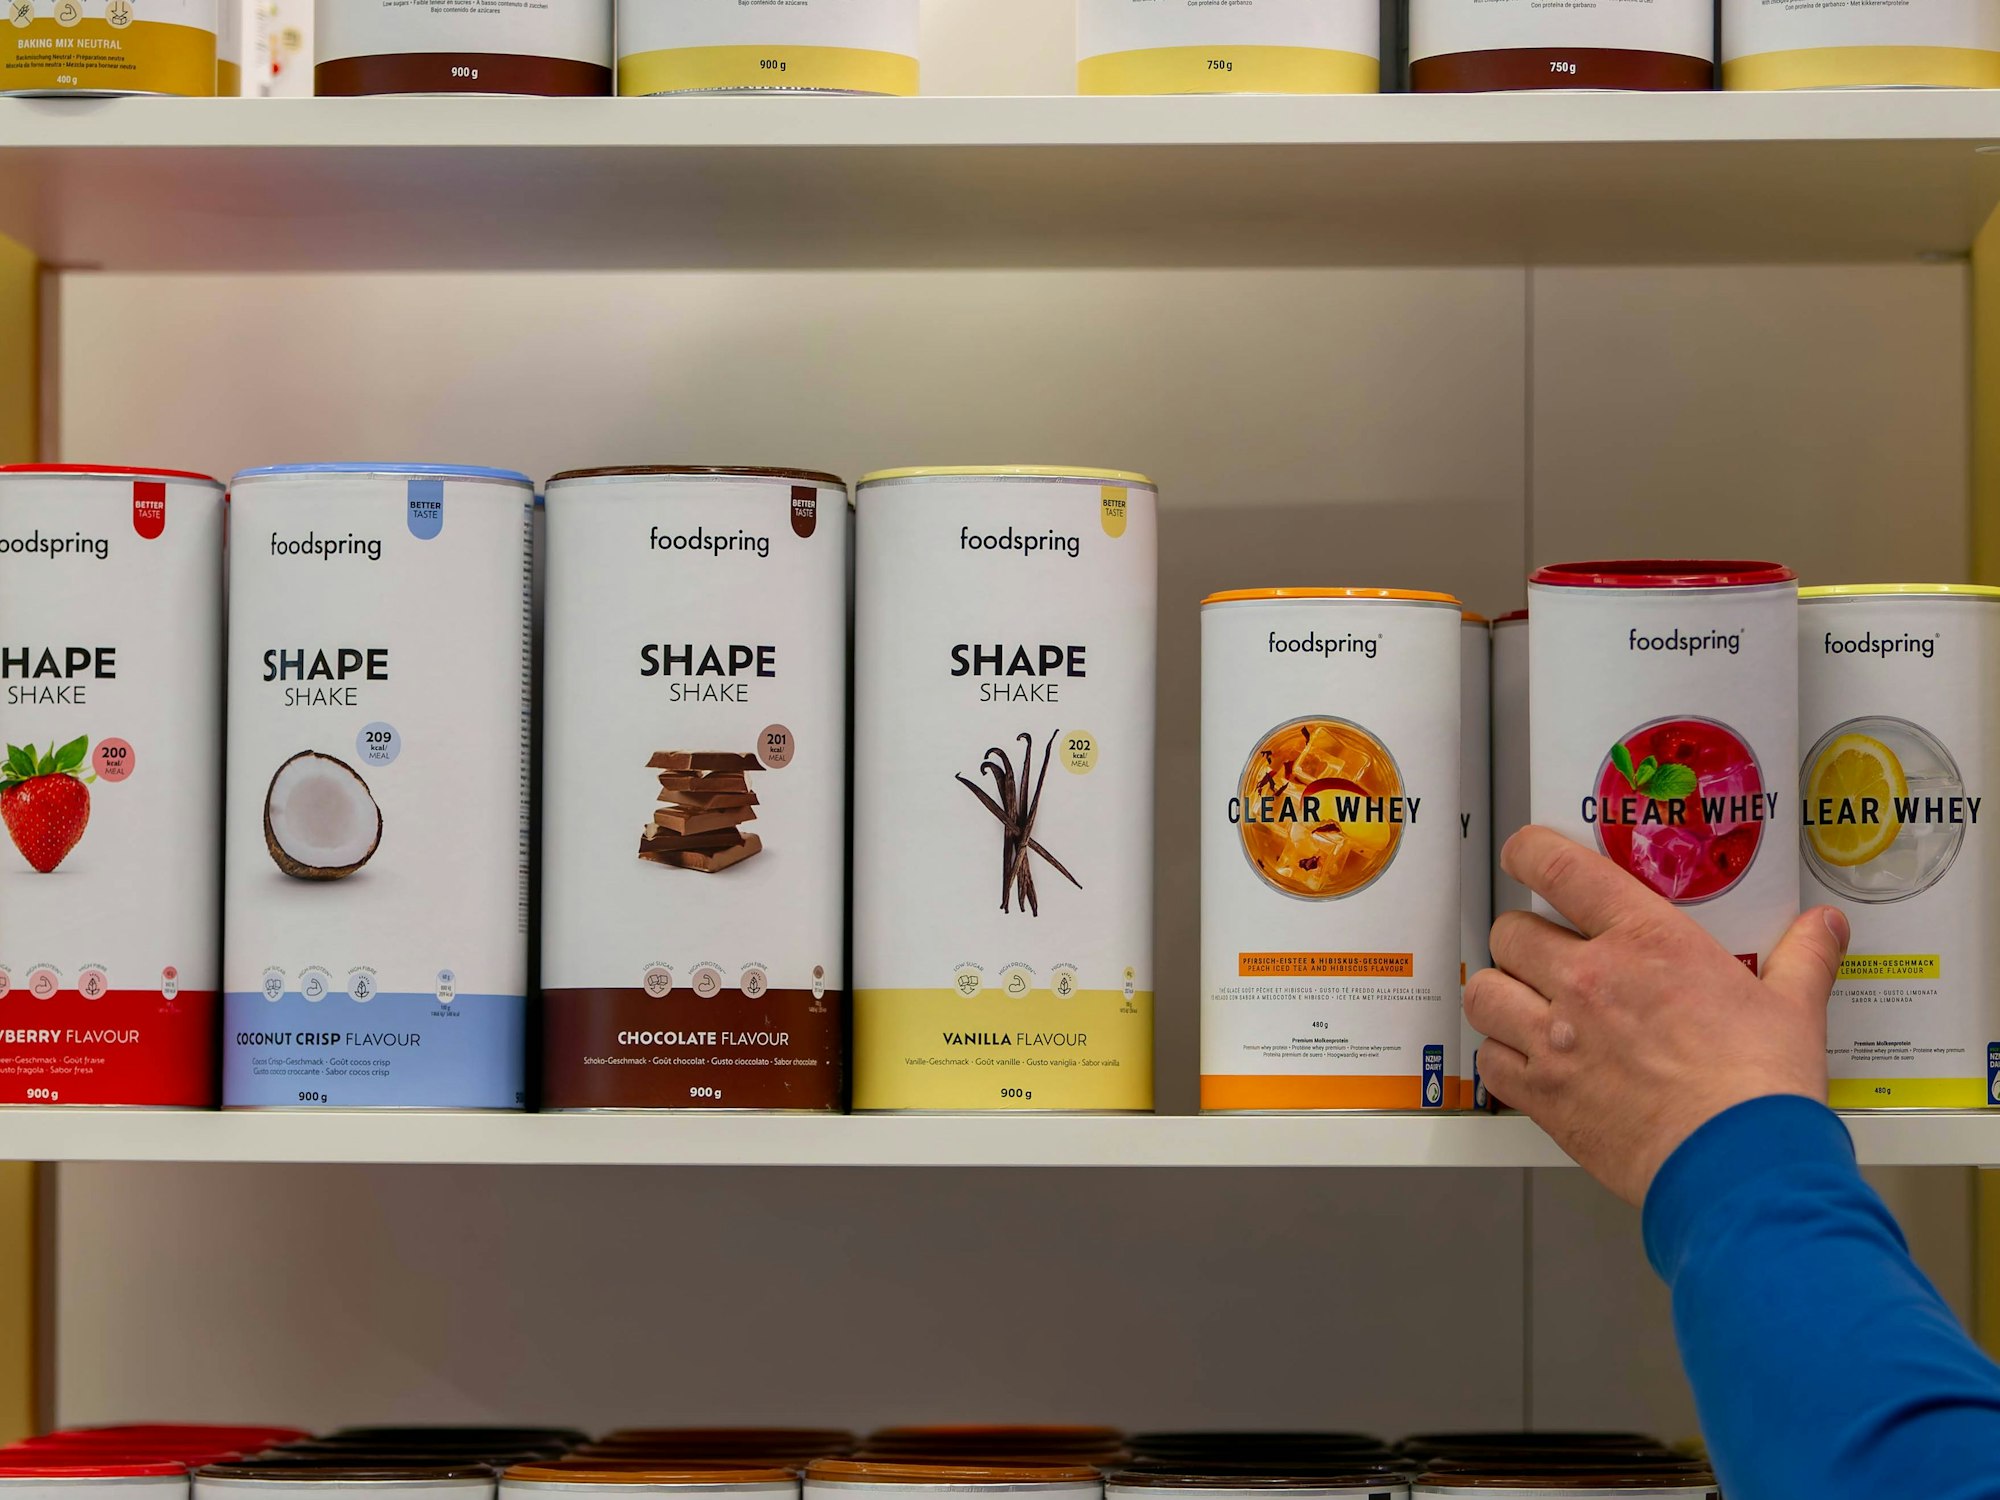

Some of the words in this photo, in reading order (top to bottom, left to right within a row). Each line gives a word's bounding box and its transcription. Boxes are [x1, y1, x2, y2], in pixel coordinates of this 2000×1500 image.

[18, 39, 52, 49] BAKING
[56, 39, 73, 48] MIX
[77, 39, 122, 50] NEUTRAL
[760, 59, 778, 70] 900
[780, 62, 786, 72] g
[1207, 60, 1224, 70] 750
[1226, 62, 1232, 72] g
[1550, 62, 1568, 73] 750
[1569, 64, 1576, 75] g
[451, 66, 471, 78] 900
[472, 69, 478, 80] g
[57, 75, 71, 84] 400
[72, 77, 78, 86] g
[135, 501, 164, 510] BETTER
[410, 501, 441, 510] BETTER
[792, 499, 815, 508] BETTER
[1102, 499, 1126, 508] BETTER
[138, 510, 161, 519] TASTE
[413, 510, 438, 519] TASTE
[795, 508, 813, 517] TASTE
[1105, 508, 1124, 517] TASTE
[0, 530, 109, 560] oodspring
[271, 531, 382, 561] foodspring
[650, 527, 769, 557] foodspring
[960, 526, 1080, 557] foodspring
[2, 647, 116, 679] HAPE
[263, 648, 388, 682] SHAPE
[640, 644, 776, 678] SHAPE
[950, 644, 1086, 678] SHAPE
[8, 685, 87, 705] SHAKE
[284, 687, 358, 707] SHAKE
[670, 683, 749, 703] SHAKE
[980, 683, 1059, 703] SHAKE
[365, 731, 392, 743] 209
[767, 733, 786, 745] 201
[1068, 739, 1091, 751] 202
[101, 747, 127, 759] 200
[368, 752, 390, 760] MEAL
[768, 754, 786, 762] MEAL
[1071, 760, 1089, 768] MEAL
[104, 768, 125, 776] MEAL
[1228, 796, 1320, 824] CLEAR
[1336, 796, 1421, 823] WHEY
[1581, 796, 1685, 825] CLEAR
[1701, 792, 1778, 823] WHEY
[1803, 797, 1879, 825] LEAR
[1895, 797, 1981, 824] WHEY
[1319, 958, 1408, 966] HIBISKUS-GESCHMACK
[1371, 965, 1404, 973] FLAVOUR
[1841, 967, 1884, 975] LEMONADE
[66, 1029, 139, 1044] FLAVOUR
[236, 1032, 292, 1046] COCONUT
[295, 1032, 341, 1046] CRISP
[345, 1032, 421, 1047] FLAVOUR
[617, 1031, 717, 1045] CHOCOLATE
[721, 1031, 789, 1046] FLAVOUR
[943, 1032, 1012, 1046] VANILLA
[1016, 1032, 1087, 1047] FLAVOUR
[63, 1056, 82, 1064] Goût
[84, 1056, 105, 1065] fraise
[252, 1058, 267, 1066] Cocos
[268, 1057, 324, 1068] Crisp-Geschmack
[330, 1057, 349, 1066] Goût
[372, 1059, 391, 1068] crisp
[583, 1056, 647, 1066] Schoko-Geschmack
[652, 1056, 671, 1066] Goût
[672, 1056, 705, 1066] chocolat
[711, 1057, 733, 1066] Gusto
[734, 1057, 769, 1066] cioccolato
[774, 1057, 792, 1066] Sabor
[792, 1057, 818, 1067] chocolate
[904, 1058, 969, 1066] Vanille-Geschmack
[975, 1057, 995, 1066] Goût
[996, 1058, 1021, 1066] vanille
[1026, 1058, 1048, 1067] Gusto
[1049, 1058, 1077, 1068] vaniglia
[1081, 1058, 1100, 1067] Sabor
[1100, 1059, 1120, 1067] vainilla
[17, 1066, 44, 1076] fragola
[50, 1066, 72, 1074] Sabor
[74, 1066, 94, 1076] fresa
[253, 1068, 269, 1076] Gusto
[287, 1068, 320, 1076] croccante
[325, 1067, 348, 1076] Sabor
[349, 1069, 370, 1077] cocos
[371, 1069, 390, 1079] crisp
[1425, 1063, 1442, 1071] DAIRY
[27, 1088, 49, 1099] 900
[51, 1091, 58, 1101] g
[298, 1091, 319, 1102] 900
[321, 1093, 328, 1104] g
[690, 1087, 713, 1097] 900
[714, 1089, 722, 1100] g
[1000, 1088, 1023, 1098] 900
[1025, 1090, 1032, 1100] g
